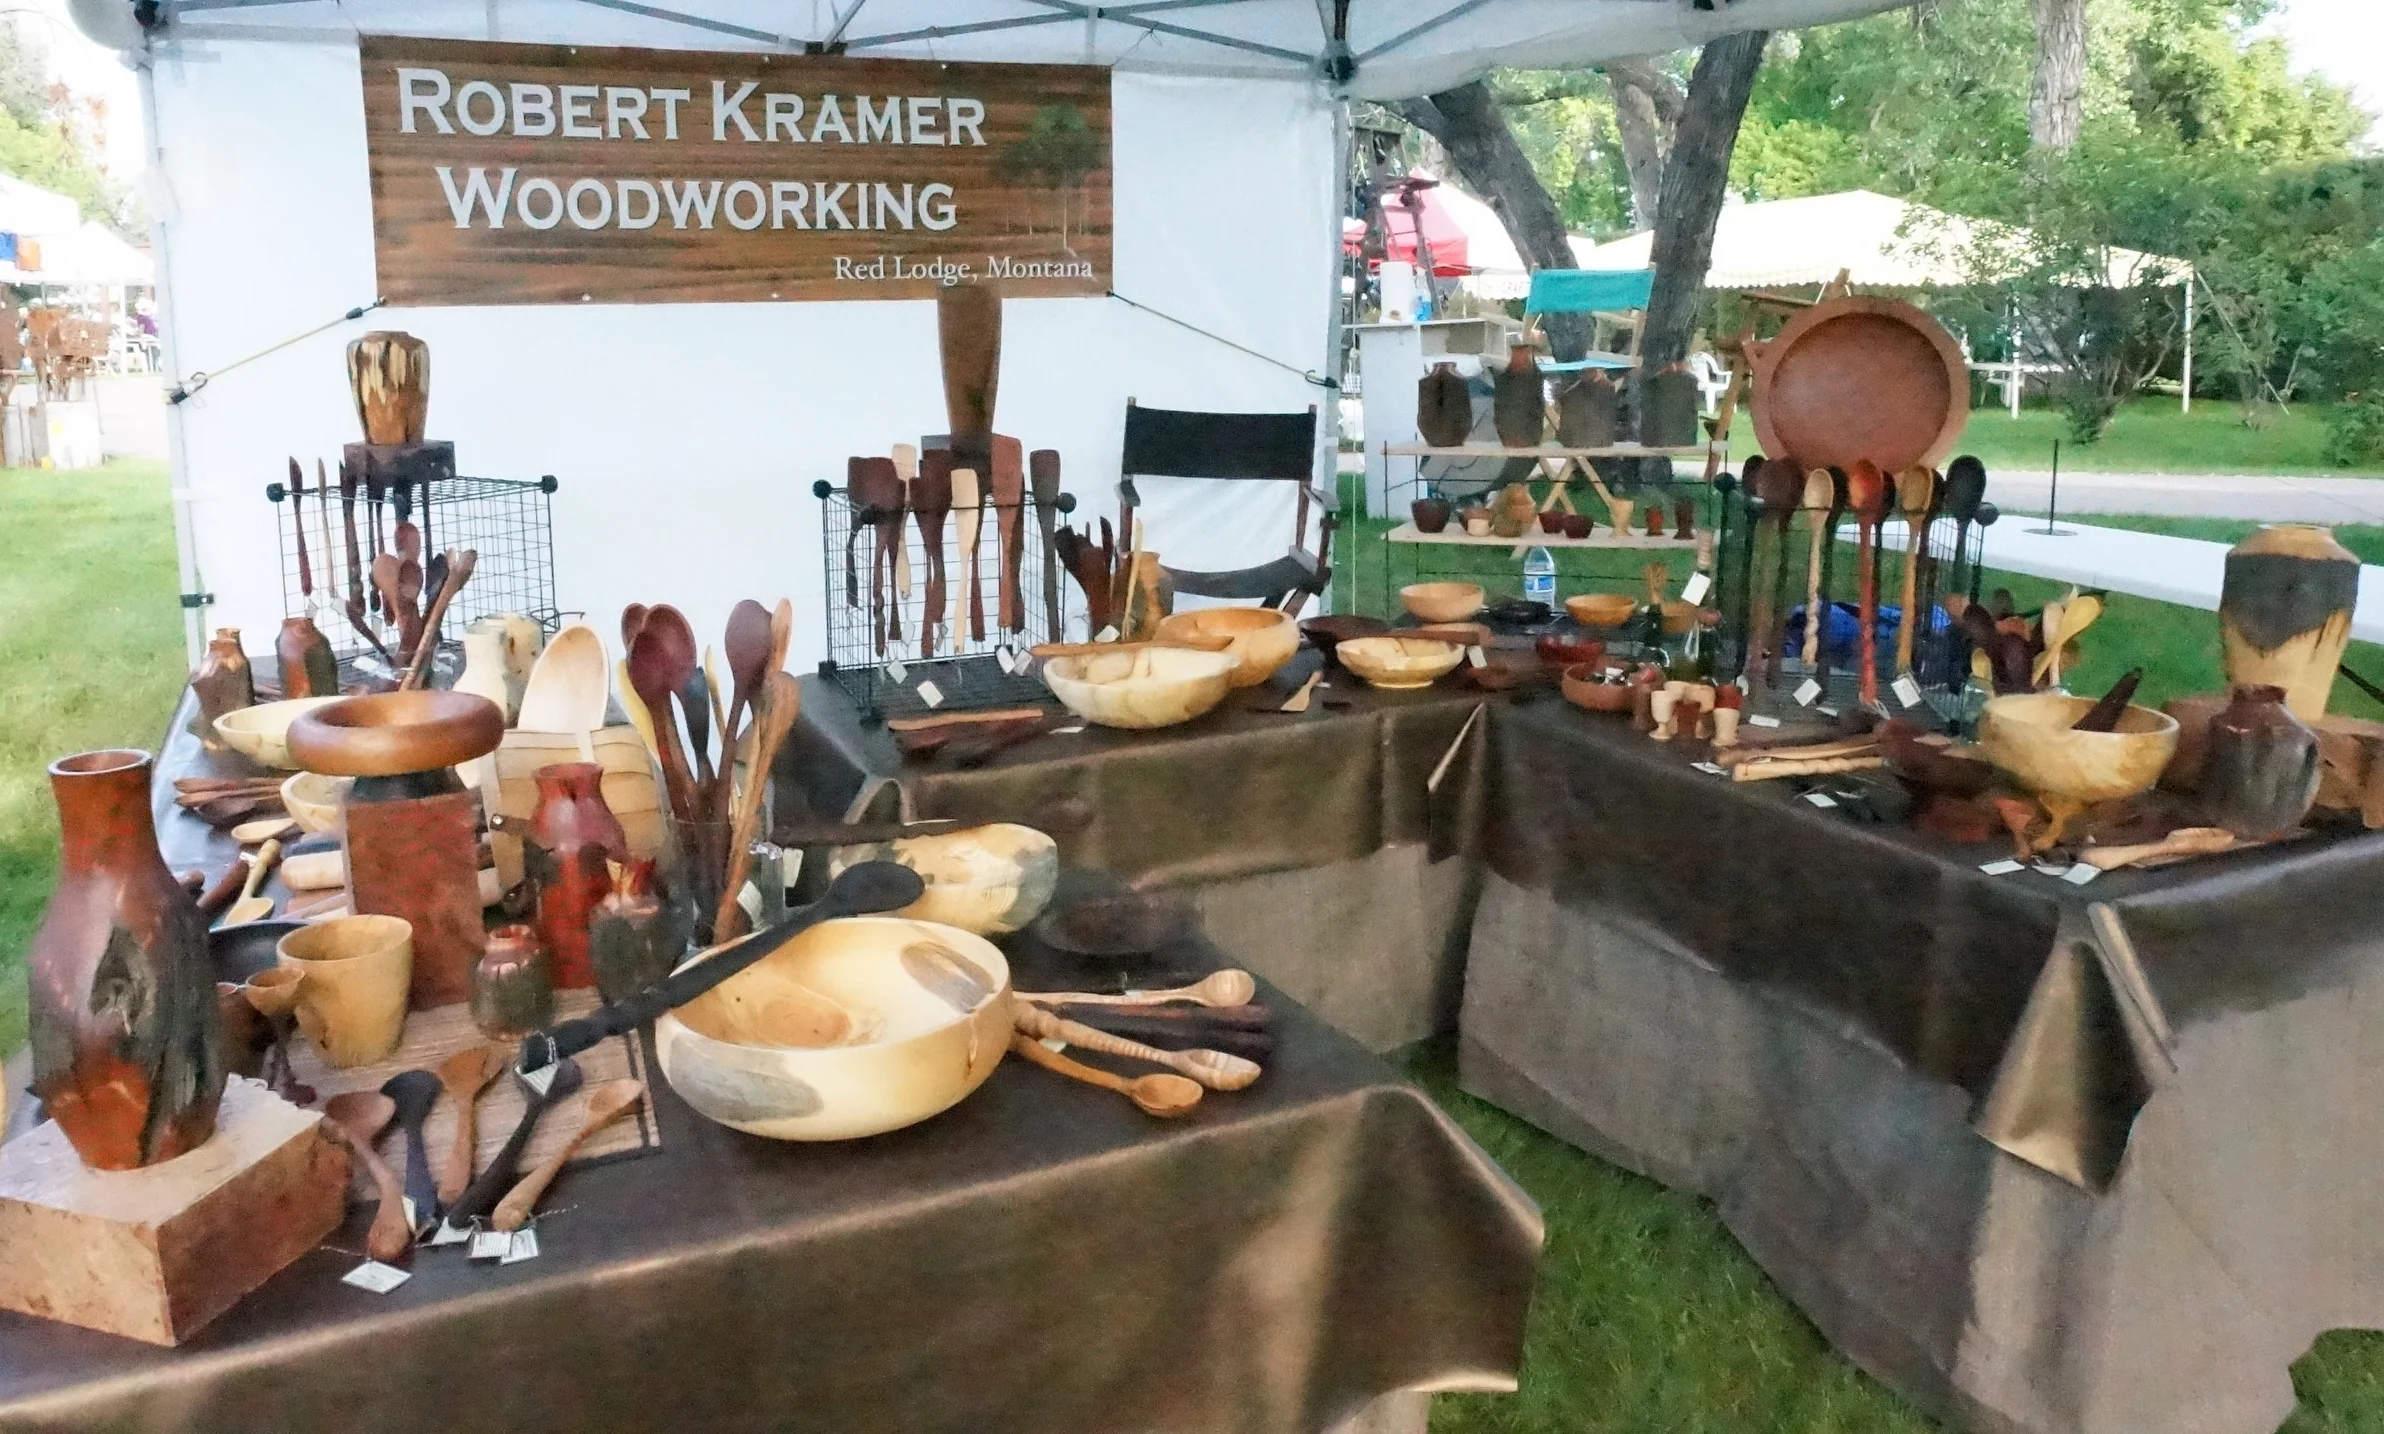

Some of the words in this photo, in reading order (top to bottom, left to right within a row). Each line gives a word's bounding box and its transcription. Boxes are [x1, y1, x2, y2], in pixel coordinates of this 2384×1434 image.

[397, 68, 690, 141] ROBERT
[712, 80, 987, 146] KRAMER
[437, 166, 957, 231] WOODWORKING
[834, 256, 885, 279] Red
[894, 255, 978, 286] Lodge,
[985, 256, 1093, 279] Montana
